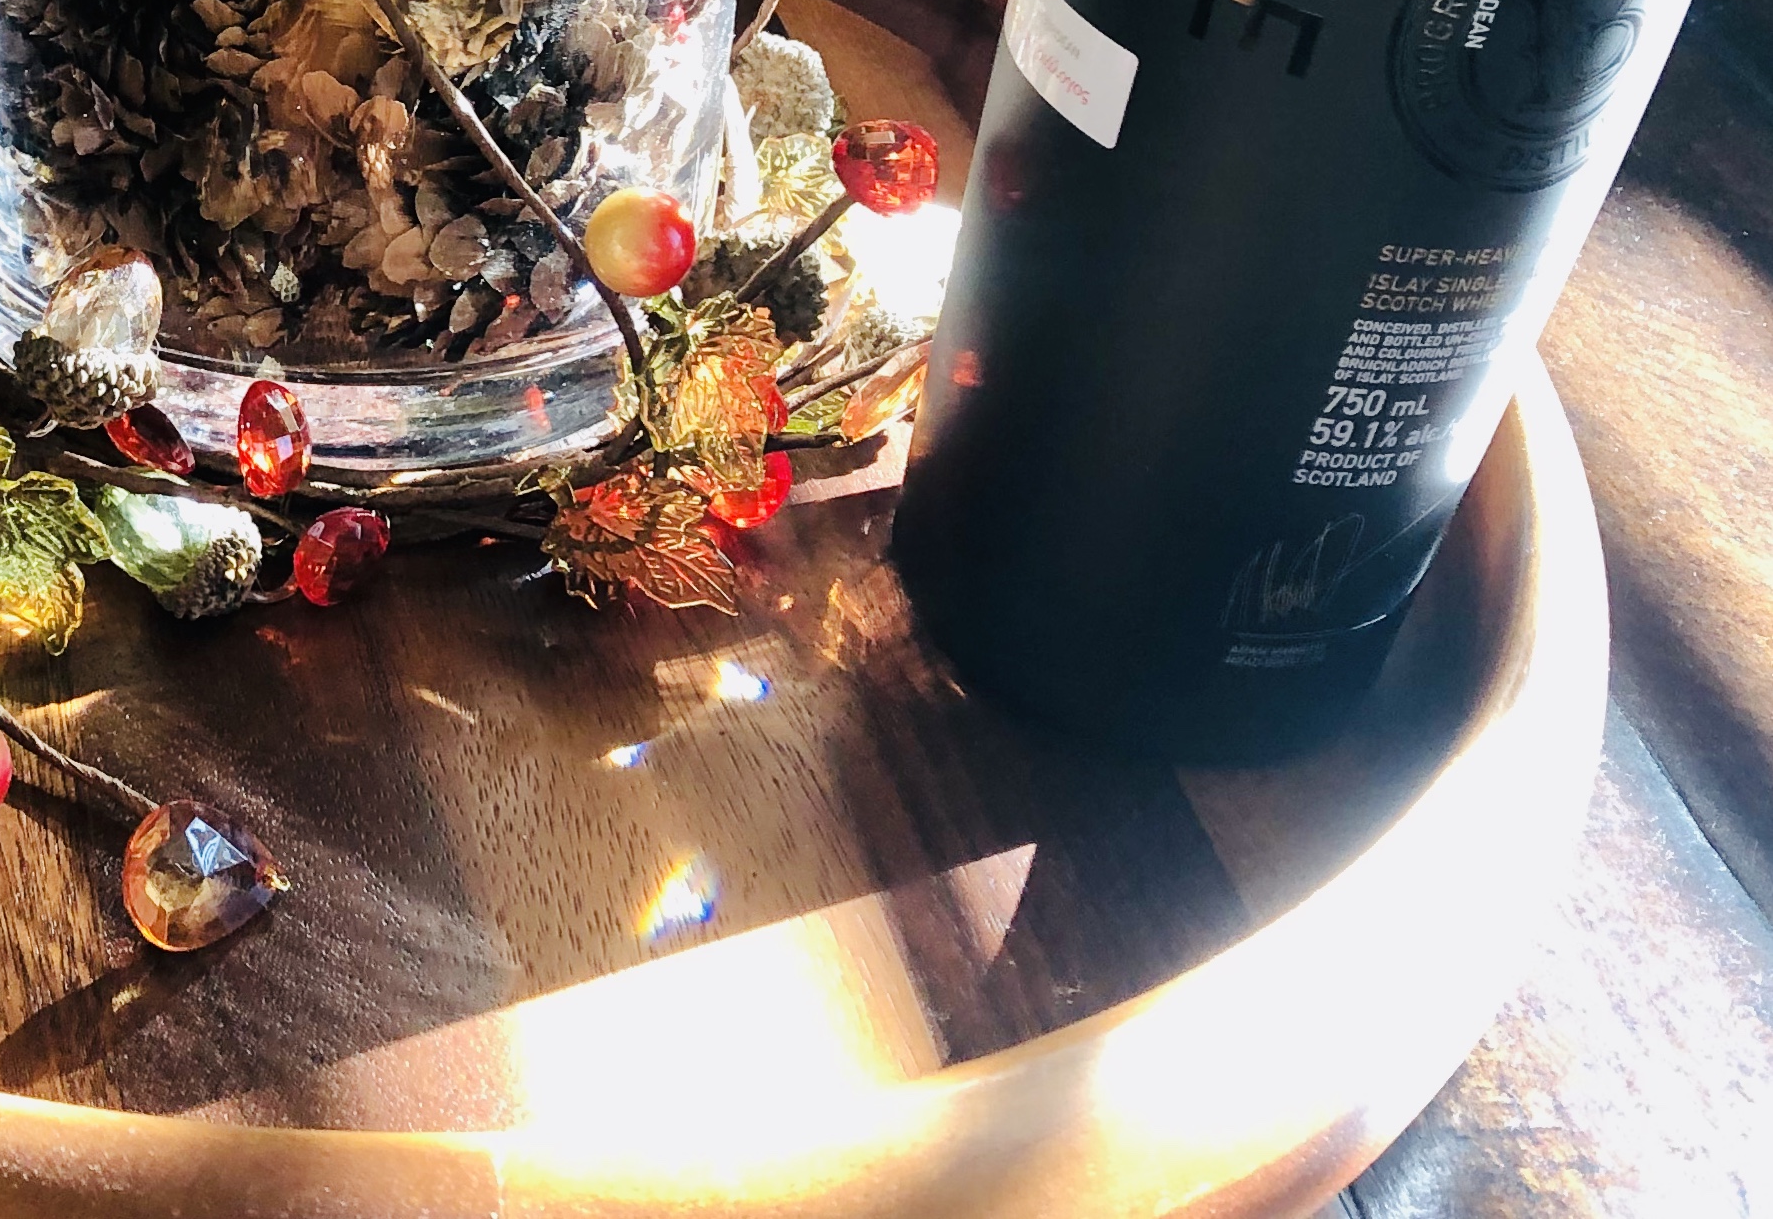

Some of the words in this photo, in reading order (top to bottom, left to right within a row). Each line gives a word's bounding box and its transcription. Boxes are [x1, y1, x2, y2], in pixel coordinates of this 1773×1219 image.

[1368, 272, 1430, 293] ISLAY
[1360, 292, 1447, 312] SCOTCH
[1347, 332, 1381, 346] AND
[1383, 334, 1442, 347] BOTTLED
[1342, 344, 1375, 358] AND
[1334, 369, 1353, 382] OF
[1323, 385, 1388, 418] 750
[1389, 394, 1430, 417] mL
[1309, 416, 1405, 449] 59.1%
[1299, 450, 1395, 469] PRODUCT
[1396, 449, 1423, 467] OF
[1292, 468, 1398, 487] SCOTLAND
